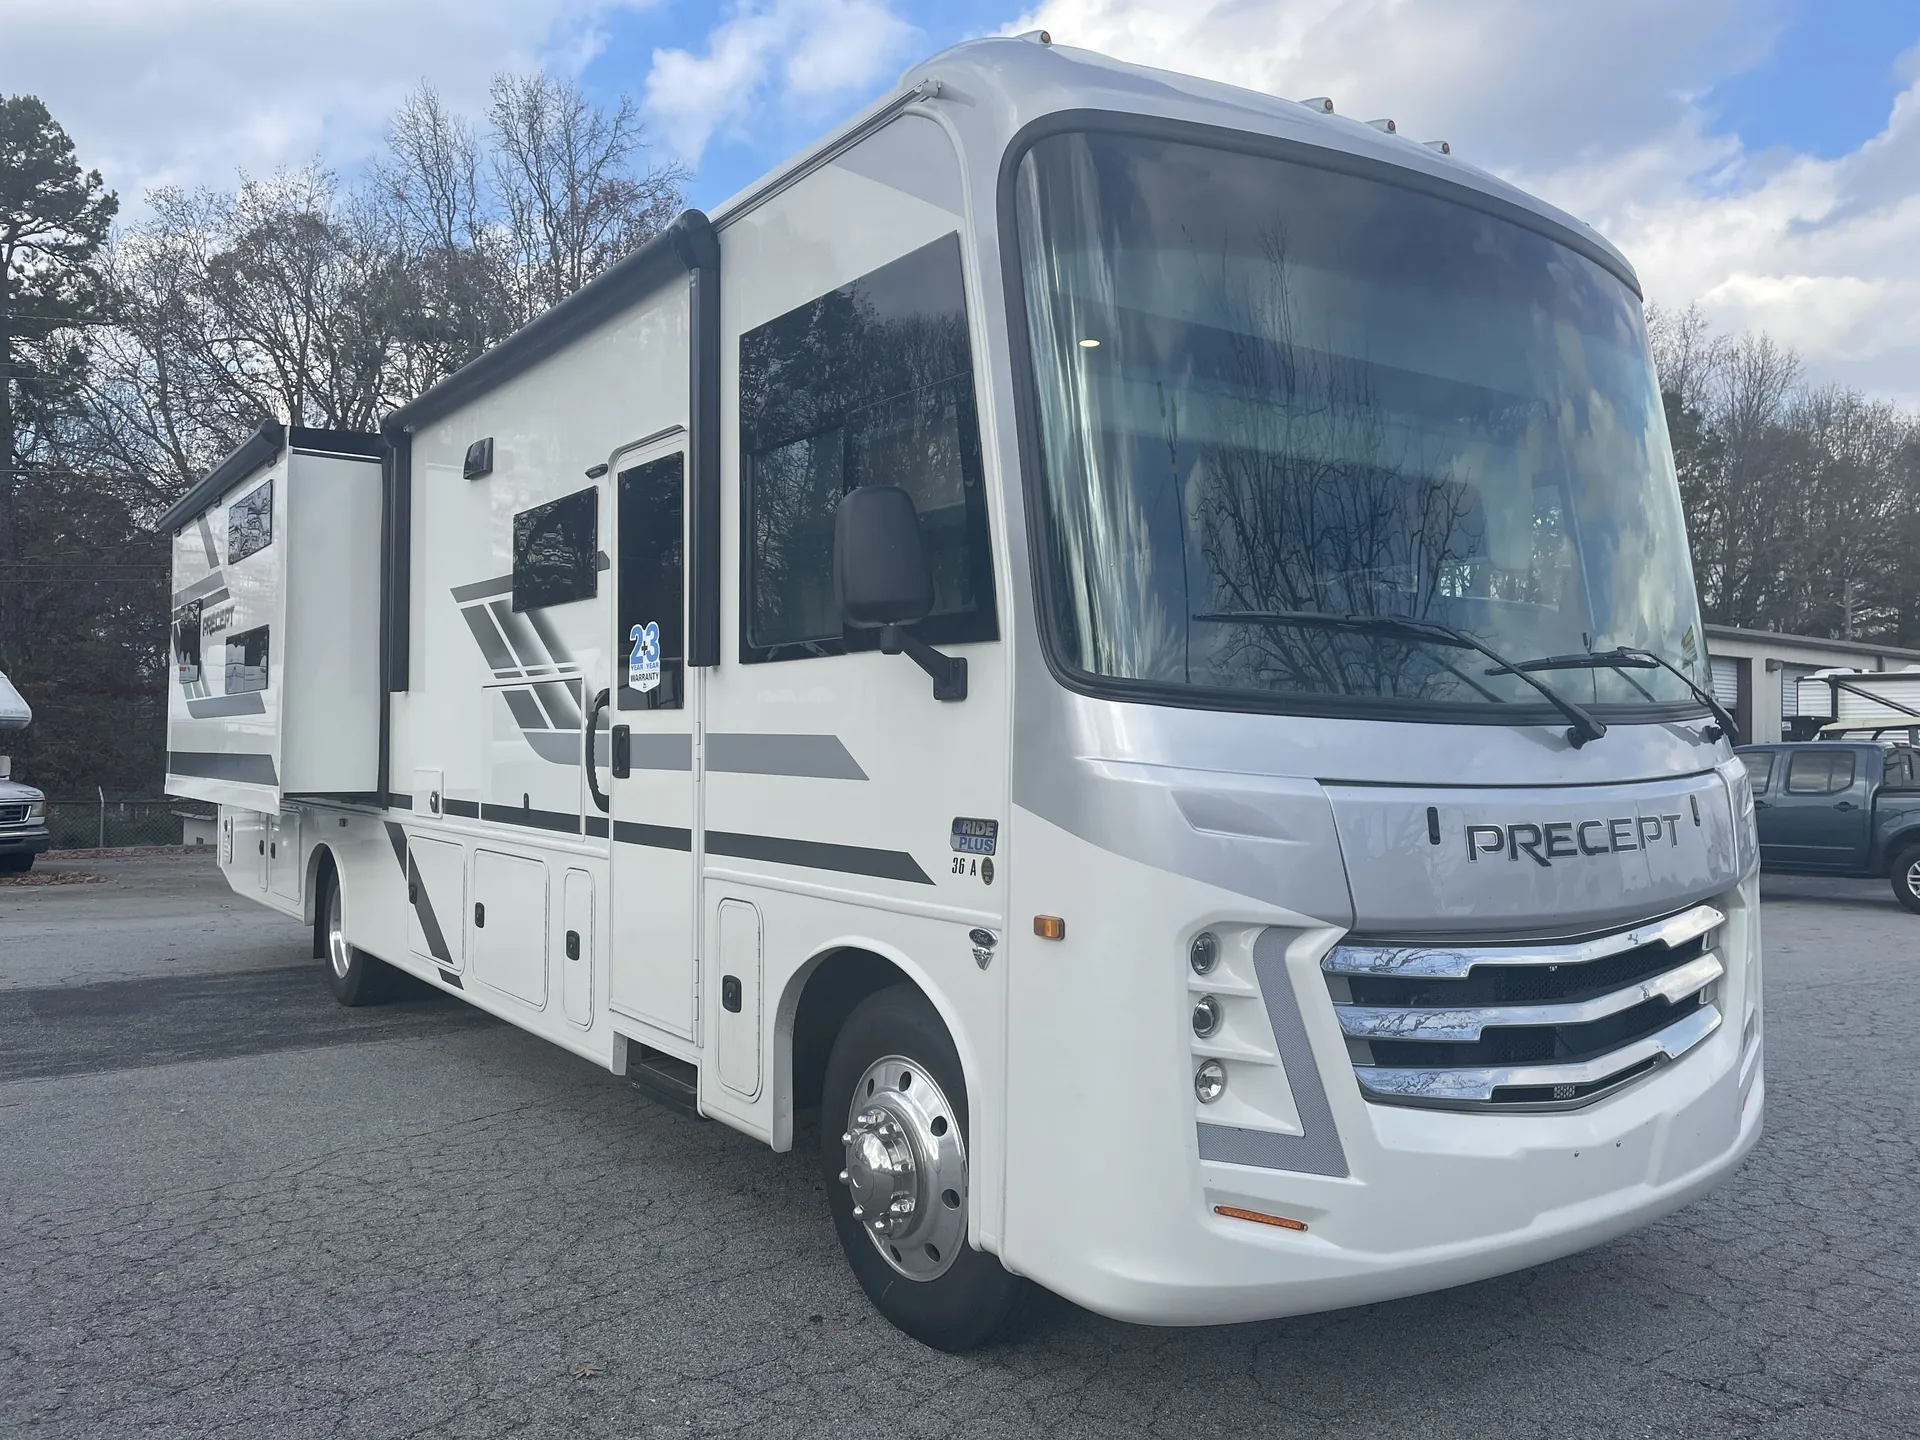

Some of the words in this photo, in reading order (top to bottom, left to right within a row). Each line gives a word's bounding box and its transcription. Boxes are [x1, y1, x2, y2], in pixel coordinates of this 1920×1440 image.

[202, 604, 235, 637] PRECEPT
[631, 663, 644, 671] YEAR
[630, 672, 659, 682] WARRANTY
[959, 836, 994, 852] PLUS
[1464, 813, 1682, 867] PRECEPT
[951, 857, 965, 874] 36
[969, 858, 977, 876] A
